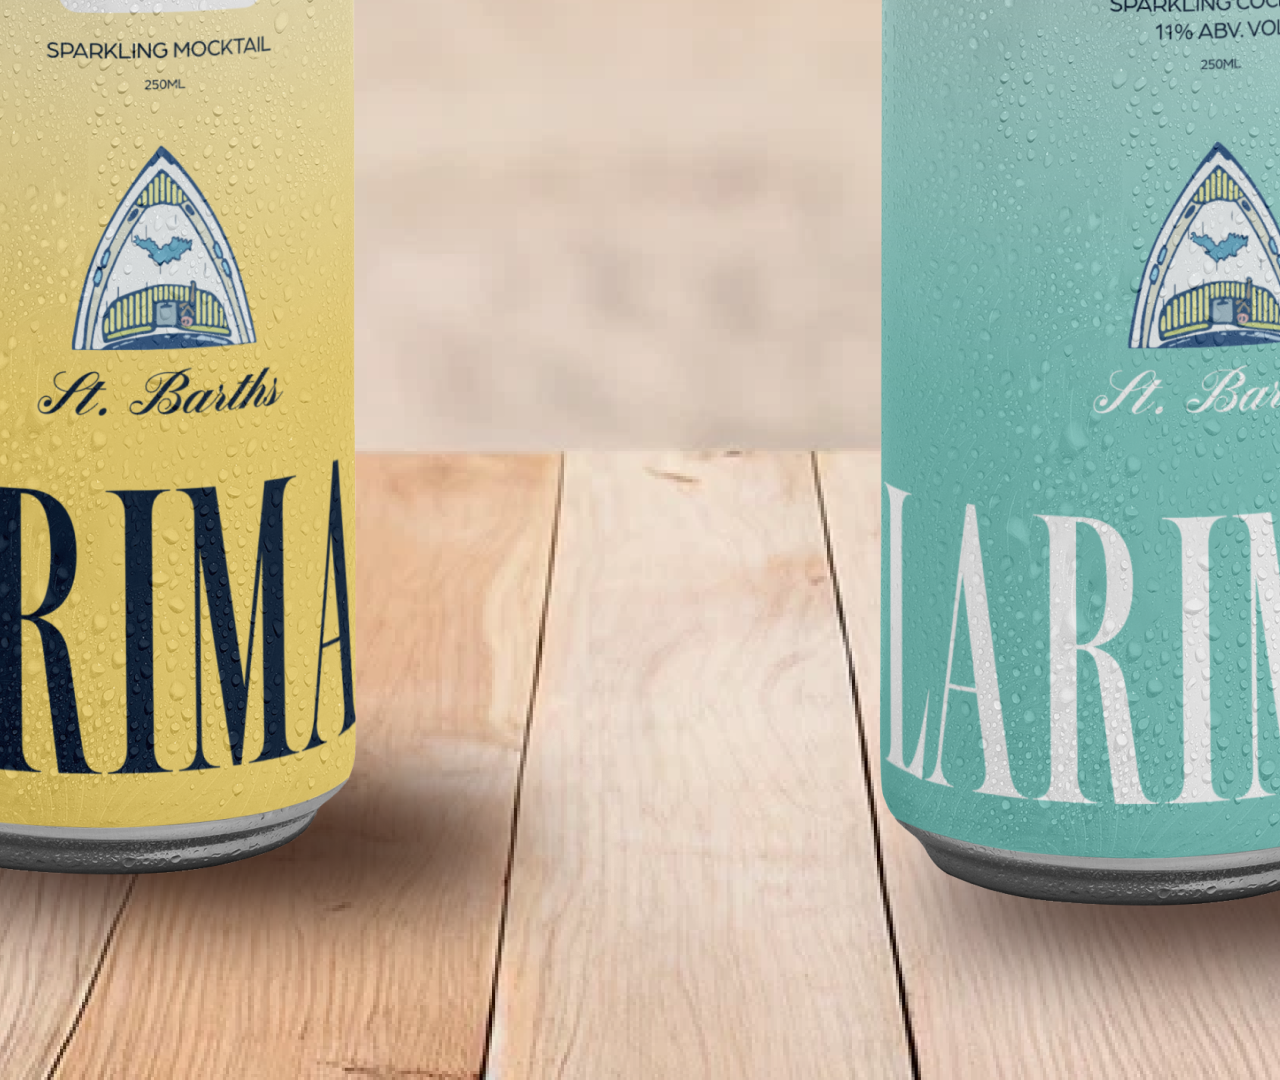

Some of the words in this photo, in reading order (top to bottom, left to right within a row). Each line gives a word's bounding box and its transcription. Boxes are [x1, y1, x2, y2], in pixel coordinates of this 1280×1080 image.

[1155, 23, 1194, 41] 11%
[1197, 21, 1244, 39] ABV.
[46, 41, 168, 60] SPARKLING
[173, 36, 271, 57] MOCKTAIL
[1200, 58, 1242, 70] 250ML
[144, 78, 186, 91] 250ML
[37, 370, 108, 416] St.
[129, 367, 283, 415] Barths
[1092, 369, 1165, 415] St.
